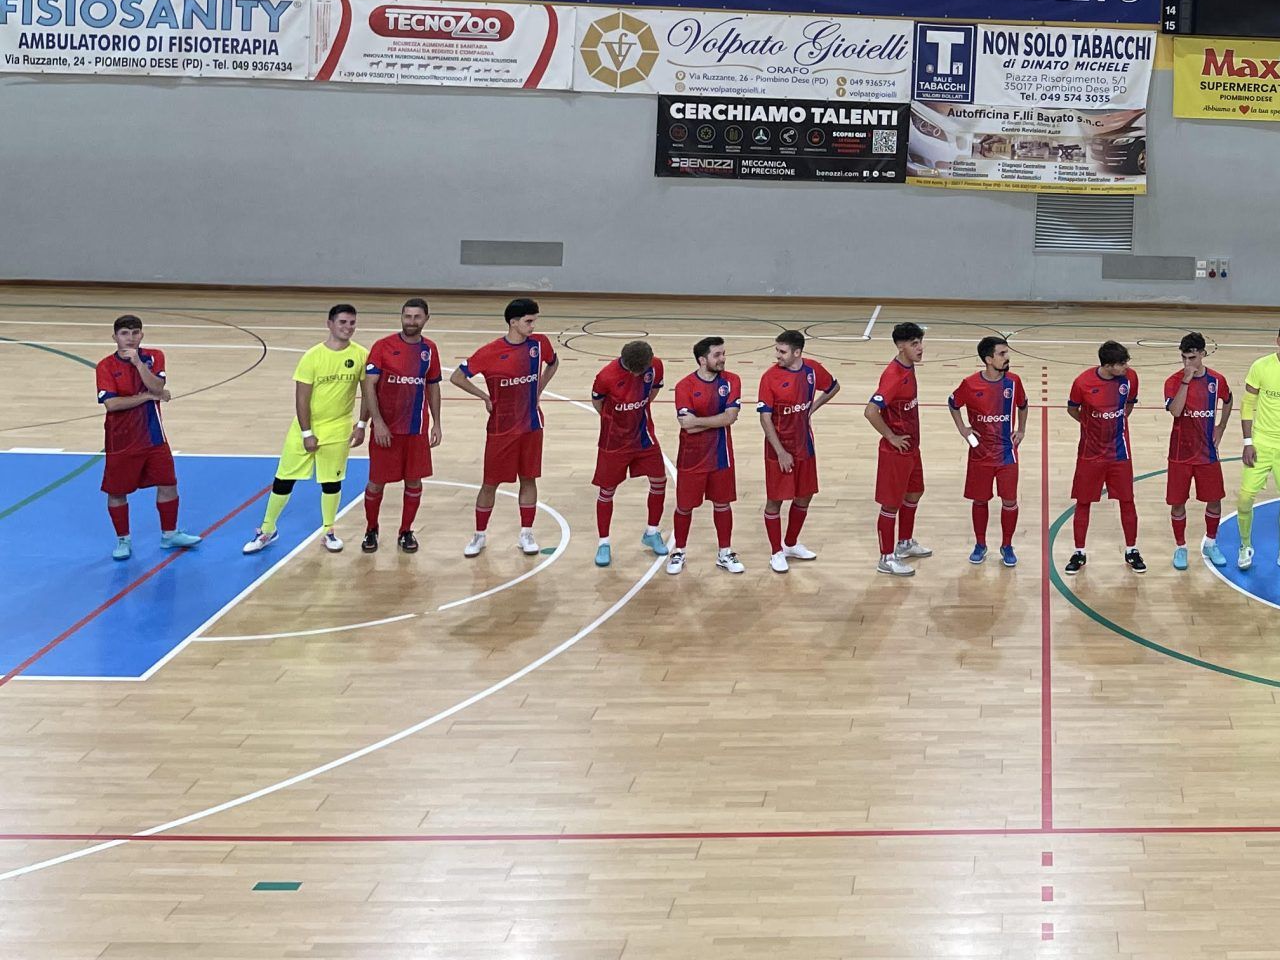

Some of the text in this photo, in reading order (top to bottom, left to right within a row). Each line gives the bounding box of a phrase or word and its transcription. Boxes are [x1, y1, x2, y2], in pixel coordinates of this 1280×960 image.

[1166, 6, 1176, 15] 14
[385, 9, 501, 39] TECNOZOO
[1165, 21, 1175, 30] 15
[19, 33, 279, 56] AMBULATORIO DI FISIOTERAPIA
[667, 17, 909, 66] Volpato Gioielli
[983, 30, 1152, 60] NON SOLO TABACCHI
[926, 30, 965, 74] T
[5, 54, 292, 72] Via Ruzzante, 24 PIOMBINO DESE (PD) Tel. 049 9367434
[1003, 59, 1130, 72] di DINATO MICHELE
[766, 66, 810, 75] ORAFO
[739, 74, 748, 82] 26
[755, 75, 790, 84] Piombino
[791, 76, 810, 84] Dese
[811, 77, 829, 86] (PD)
[849, 79, 896, 88] 049 9365754
[918, 81, 966, 91] TABACCHI
[1006, 73, 1126, 87] Piazza Risorgimento, 5/1
[1004, 83, 1127, 94] 35017 Piombino Dese PD
[1020, 93, 1110, 103] Tel. 049 574 3035
[670, 103, 898, 125] CERCHIAMO TALENTI
[947, 108, 1104, 127] Autofficina F.lli Bavato s.n.c.
[741, 159, 787, 168] MECCANICA
[751, 167, 795, 175] PRECISIONE
[816, 169, 859, 177] benozzi.com
